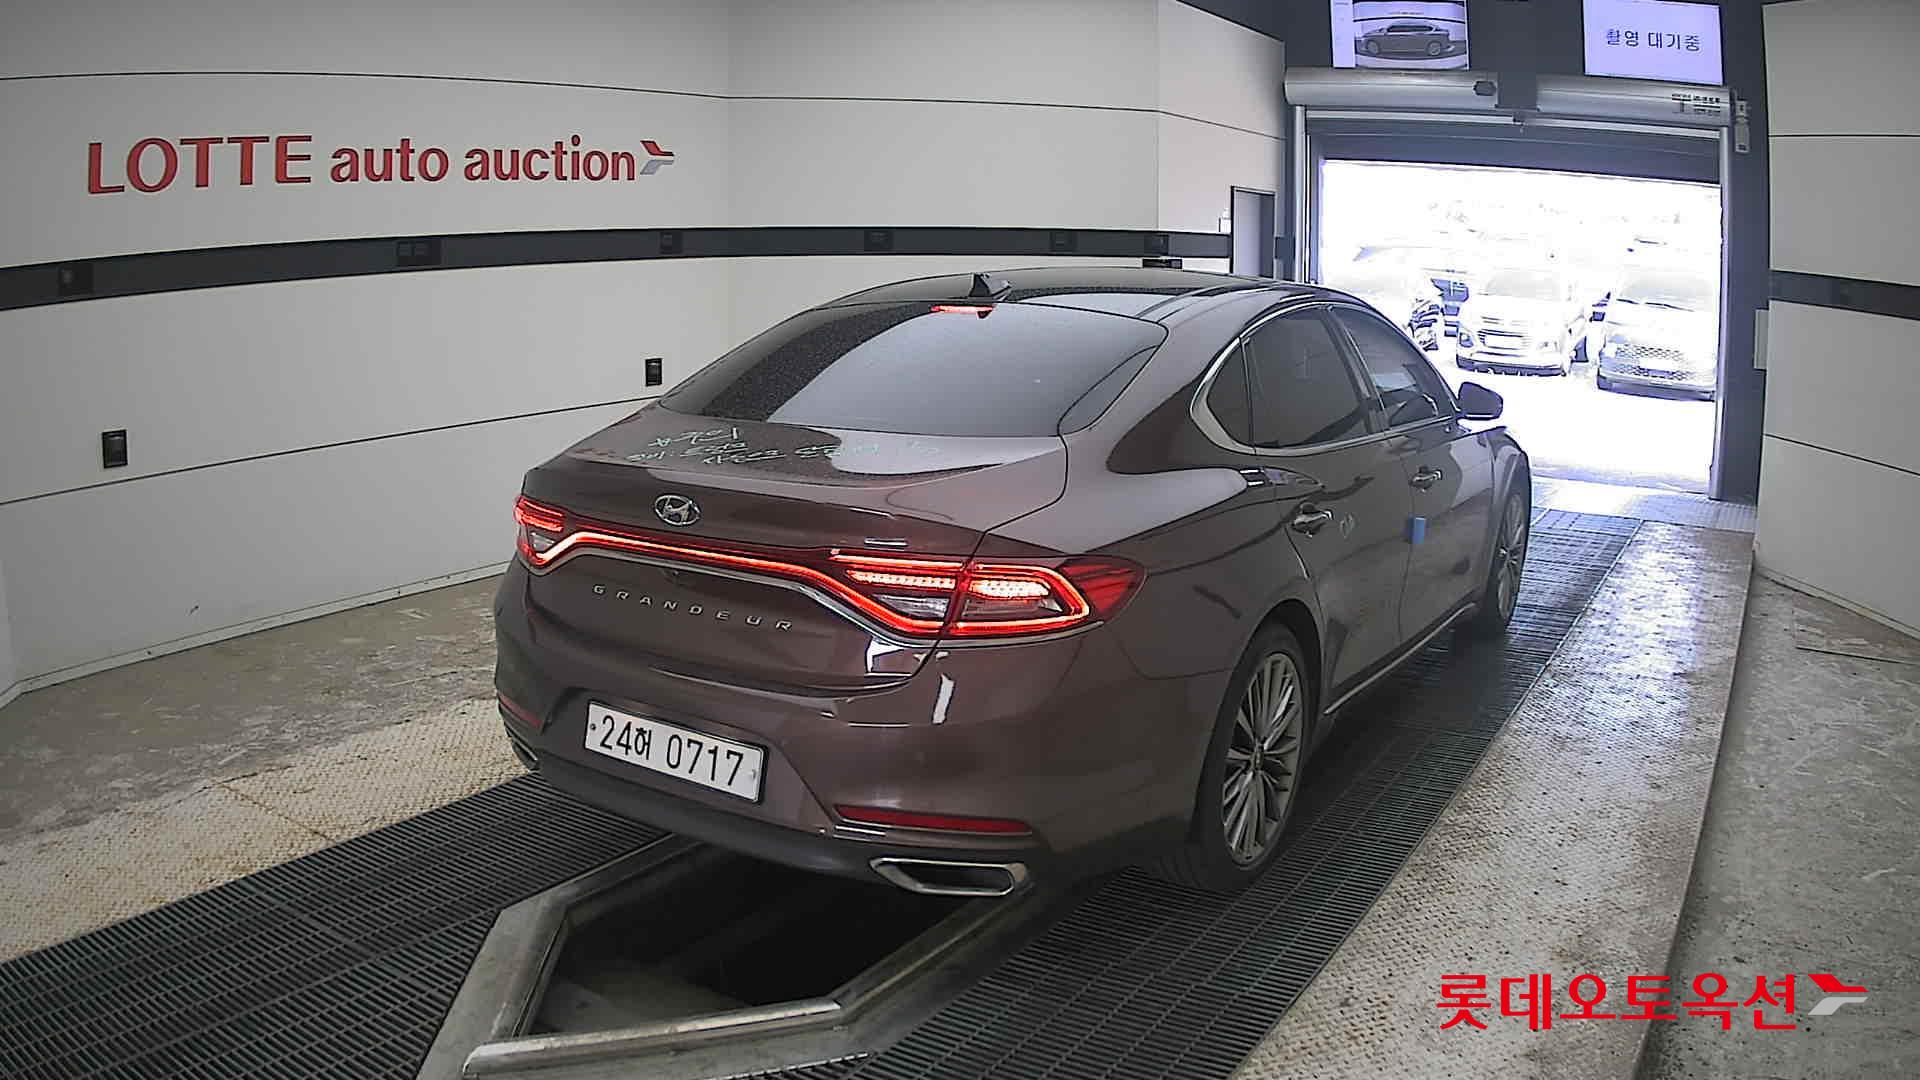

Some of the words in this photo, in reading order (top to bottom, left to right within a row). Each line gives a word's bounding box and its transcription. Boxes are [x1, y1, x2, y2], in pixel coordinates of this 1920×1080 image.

[1647, 31, 1700, 52] 대기중
[88, 135, 312, 194] LOTTE
[329, 137, 449, 183] auto
[463, 135, 636, 182] auction
[592, 584, 792, 631] GRANDEUR
[599, 715, 653, 760] 24허
[666, 734, 743, 786] 0717
